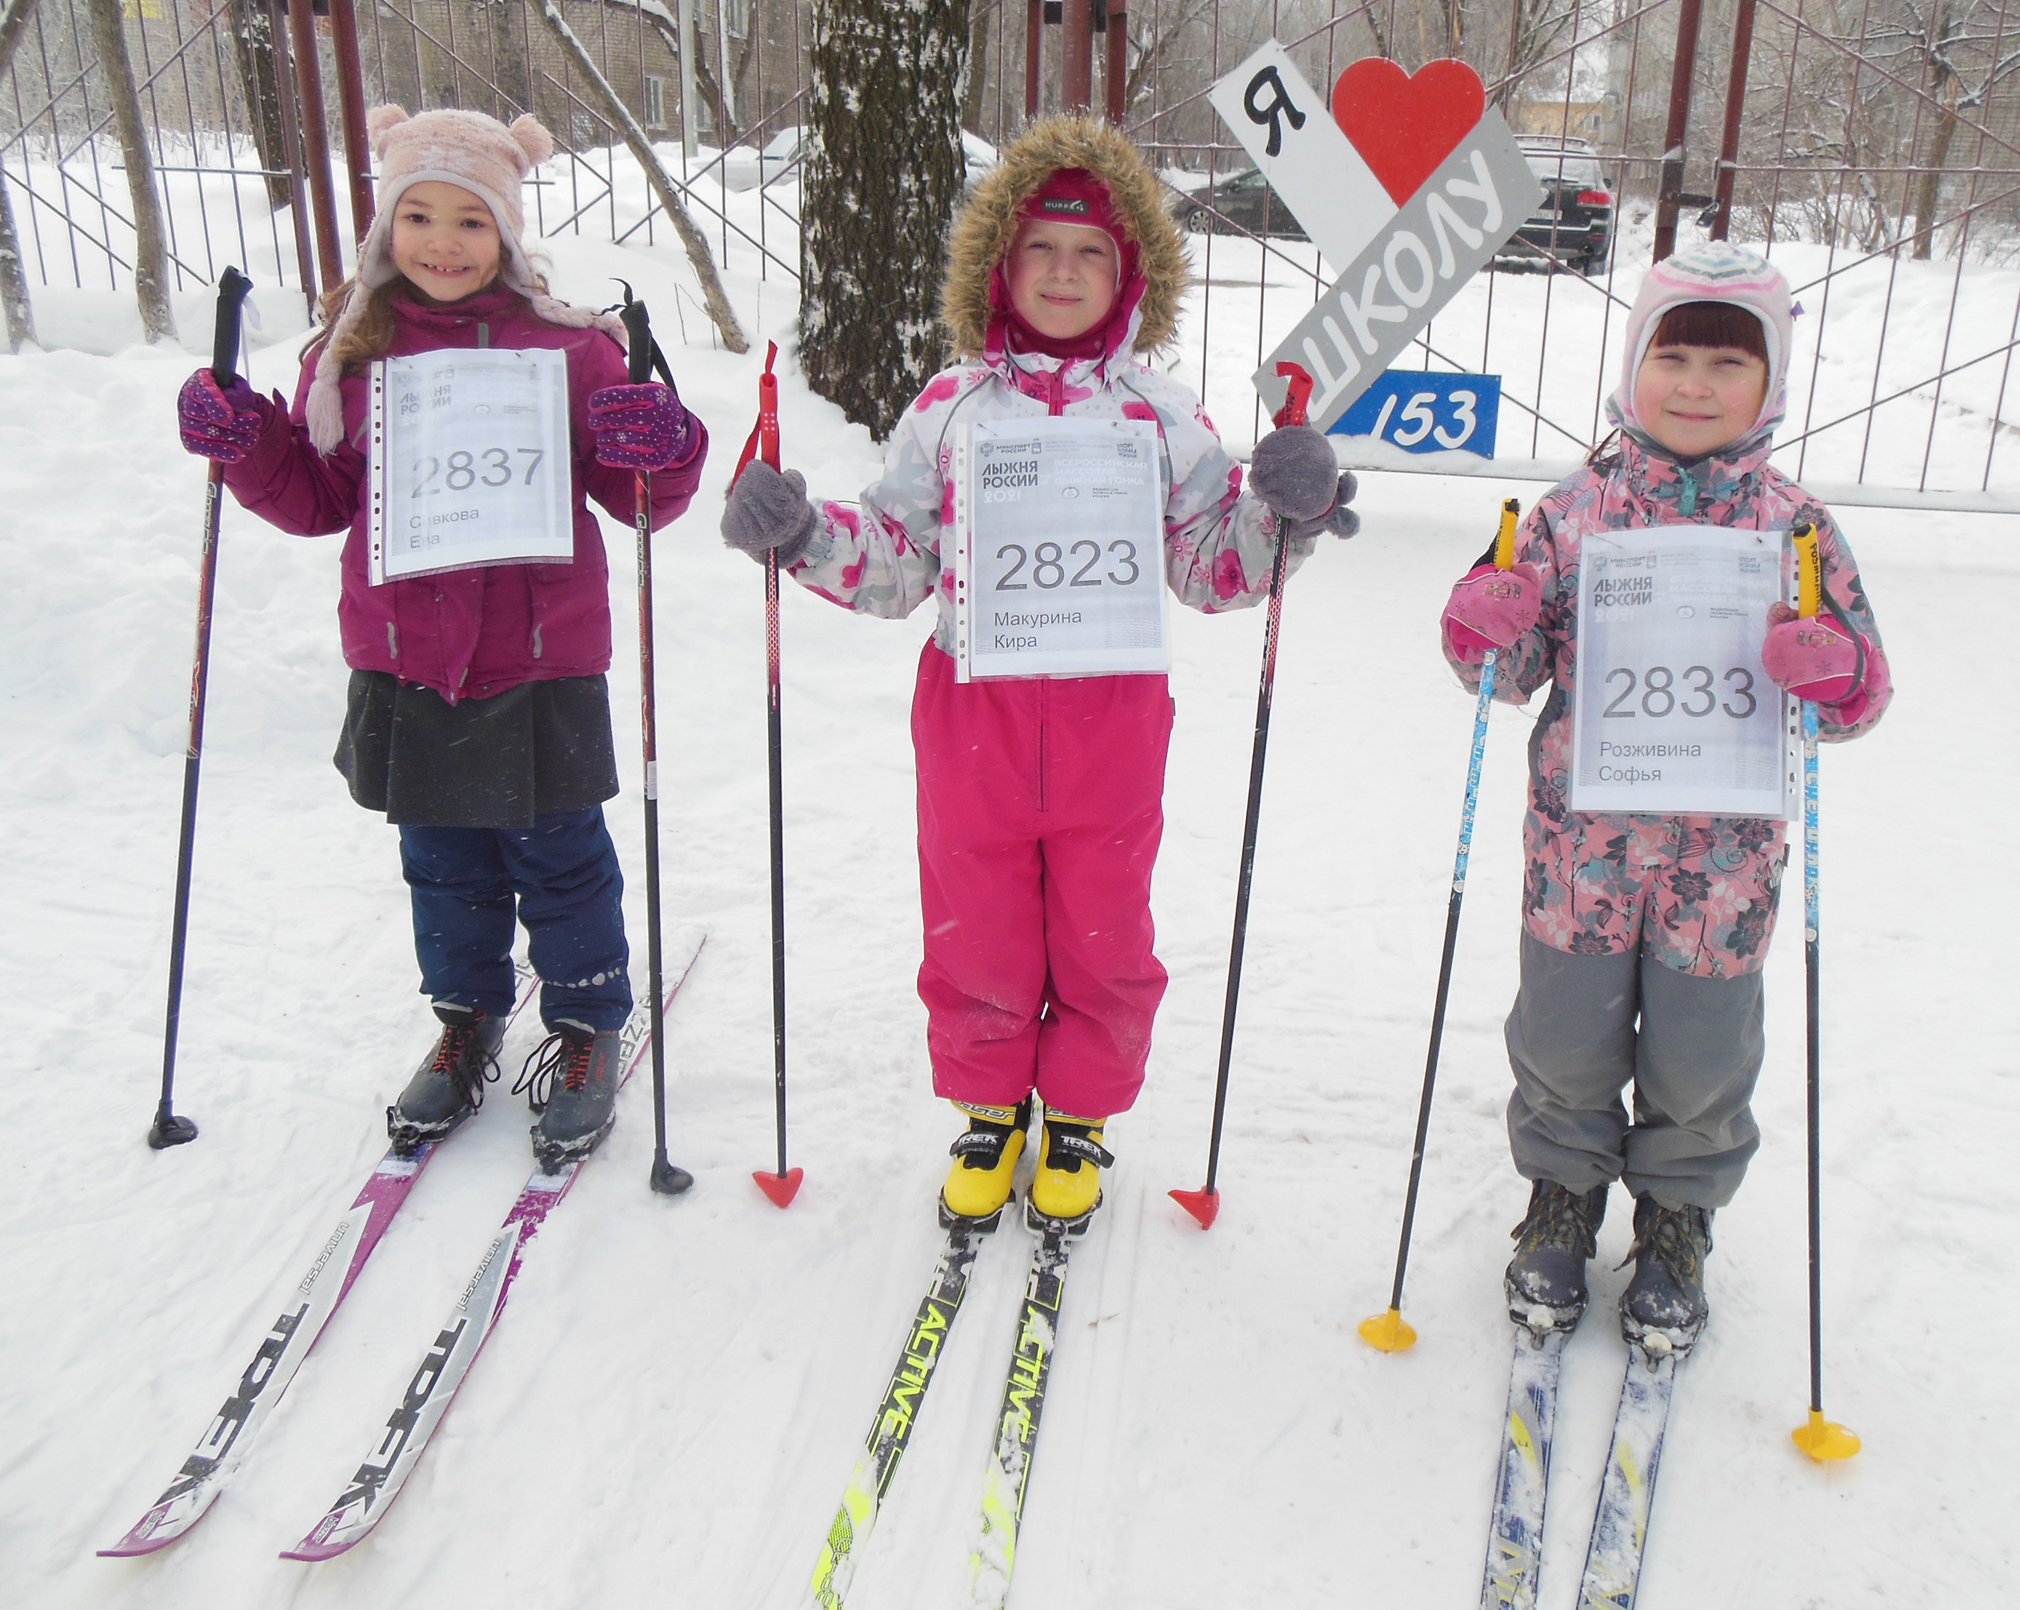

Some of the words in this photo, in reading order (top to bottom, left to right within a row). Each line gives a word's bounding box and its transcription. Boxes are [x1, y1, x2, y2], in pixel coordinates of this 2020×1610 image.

[1243, 65, 1306, 157] Я
[1300, 149, 1502, 423] ШКОЛУ
[400, 384, 451, 404] ЛЫНЯ
[401, 395, 451, 415] РОИИ
[1369, 390, 1478, 449] 153
[411, 447, 545, 499] 2837
[982, 461, 1038, 476] ЛЫЖНЯ
[983, 474, 1038, 489] РОССИИ
[1109, 477, 1145, 485] ГОНКА
[984, 489, 1021, 503] 2021
[995, 539, 1140, 591] 2823
[1593, 576, 1652, 592] ЛЫЖНЯ
[1594, 591, 1652, 607] РОССИИ
[994, 611, 1082, 629] Макурина
[994, 634, 1037, 651] Кира
[1602, 665, 1757, 719] 2833
[1600, 741, 1702, 758] Розживина
[1599, 766, 1662, 785] Софья
[959, 1101, 1015, 1119] aser
[1061, 1135, 1101, 1158] TREK
[299, 1221, 350, 1296] universal
[456, 1240, 502, 1312] universal
[880, 1304, 948, 1440] ACTIVE
